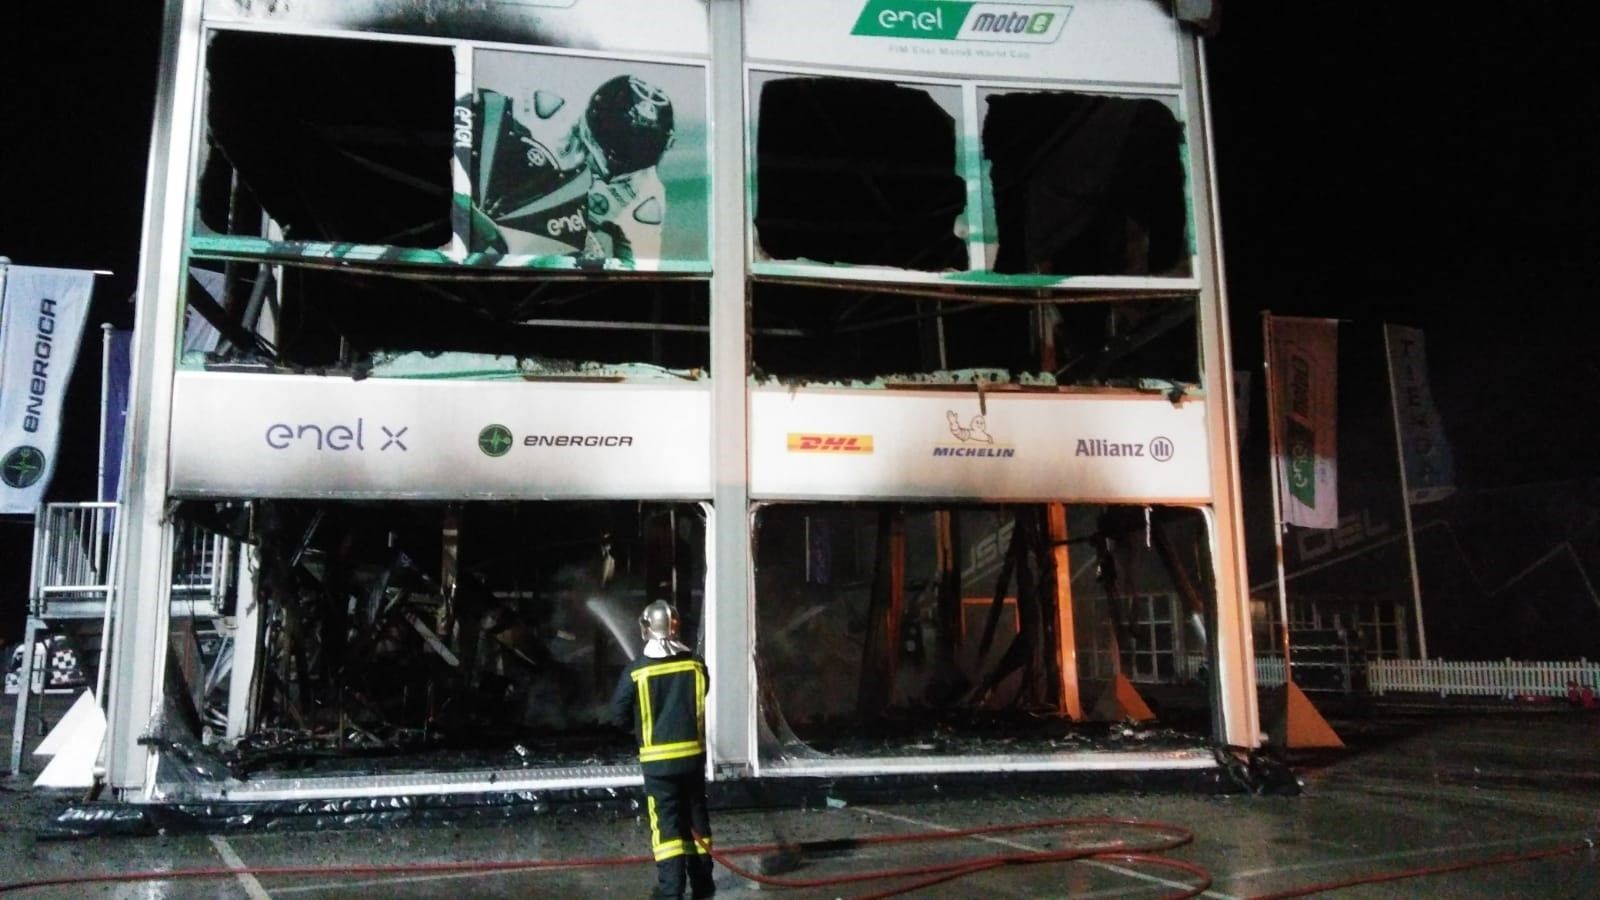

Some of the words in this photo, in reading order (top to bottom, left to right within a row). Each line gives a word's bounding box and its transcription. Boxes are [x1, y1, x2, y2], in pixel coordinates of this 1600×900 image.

[878, 8, 943, 31] enel
[455, 105, 472, 148] enel
[547, 211, 586, 236] enel
[23, 298, 57, 435] ENERGICA
[266, 418, 364, 451] enel
[523, 434, 633, 448] ENERGICA
[799, 436, 864, 452] DHL
[932, 446, 1015, 459] MICHELIN
[1075, 438, 1145, 458] Allianz
